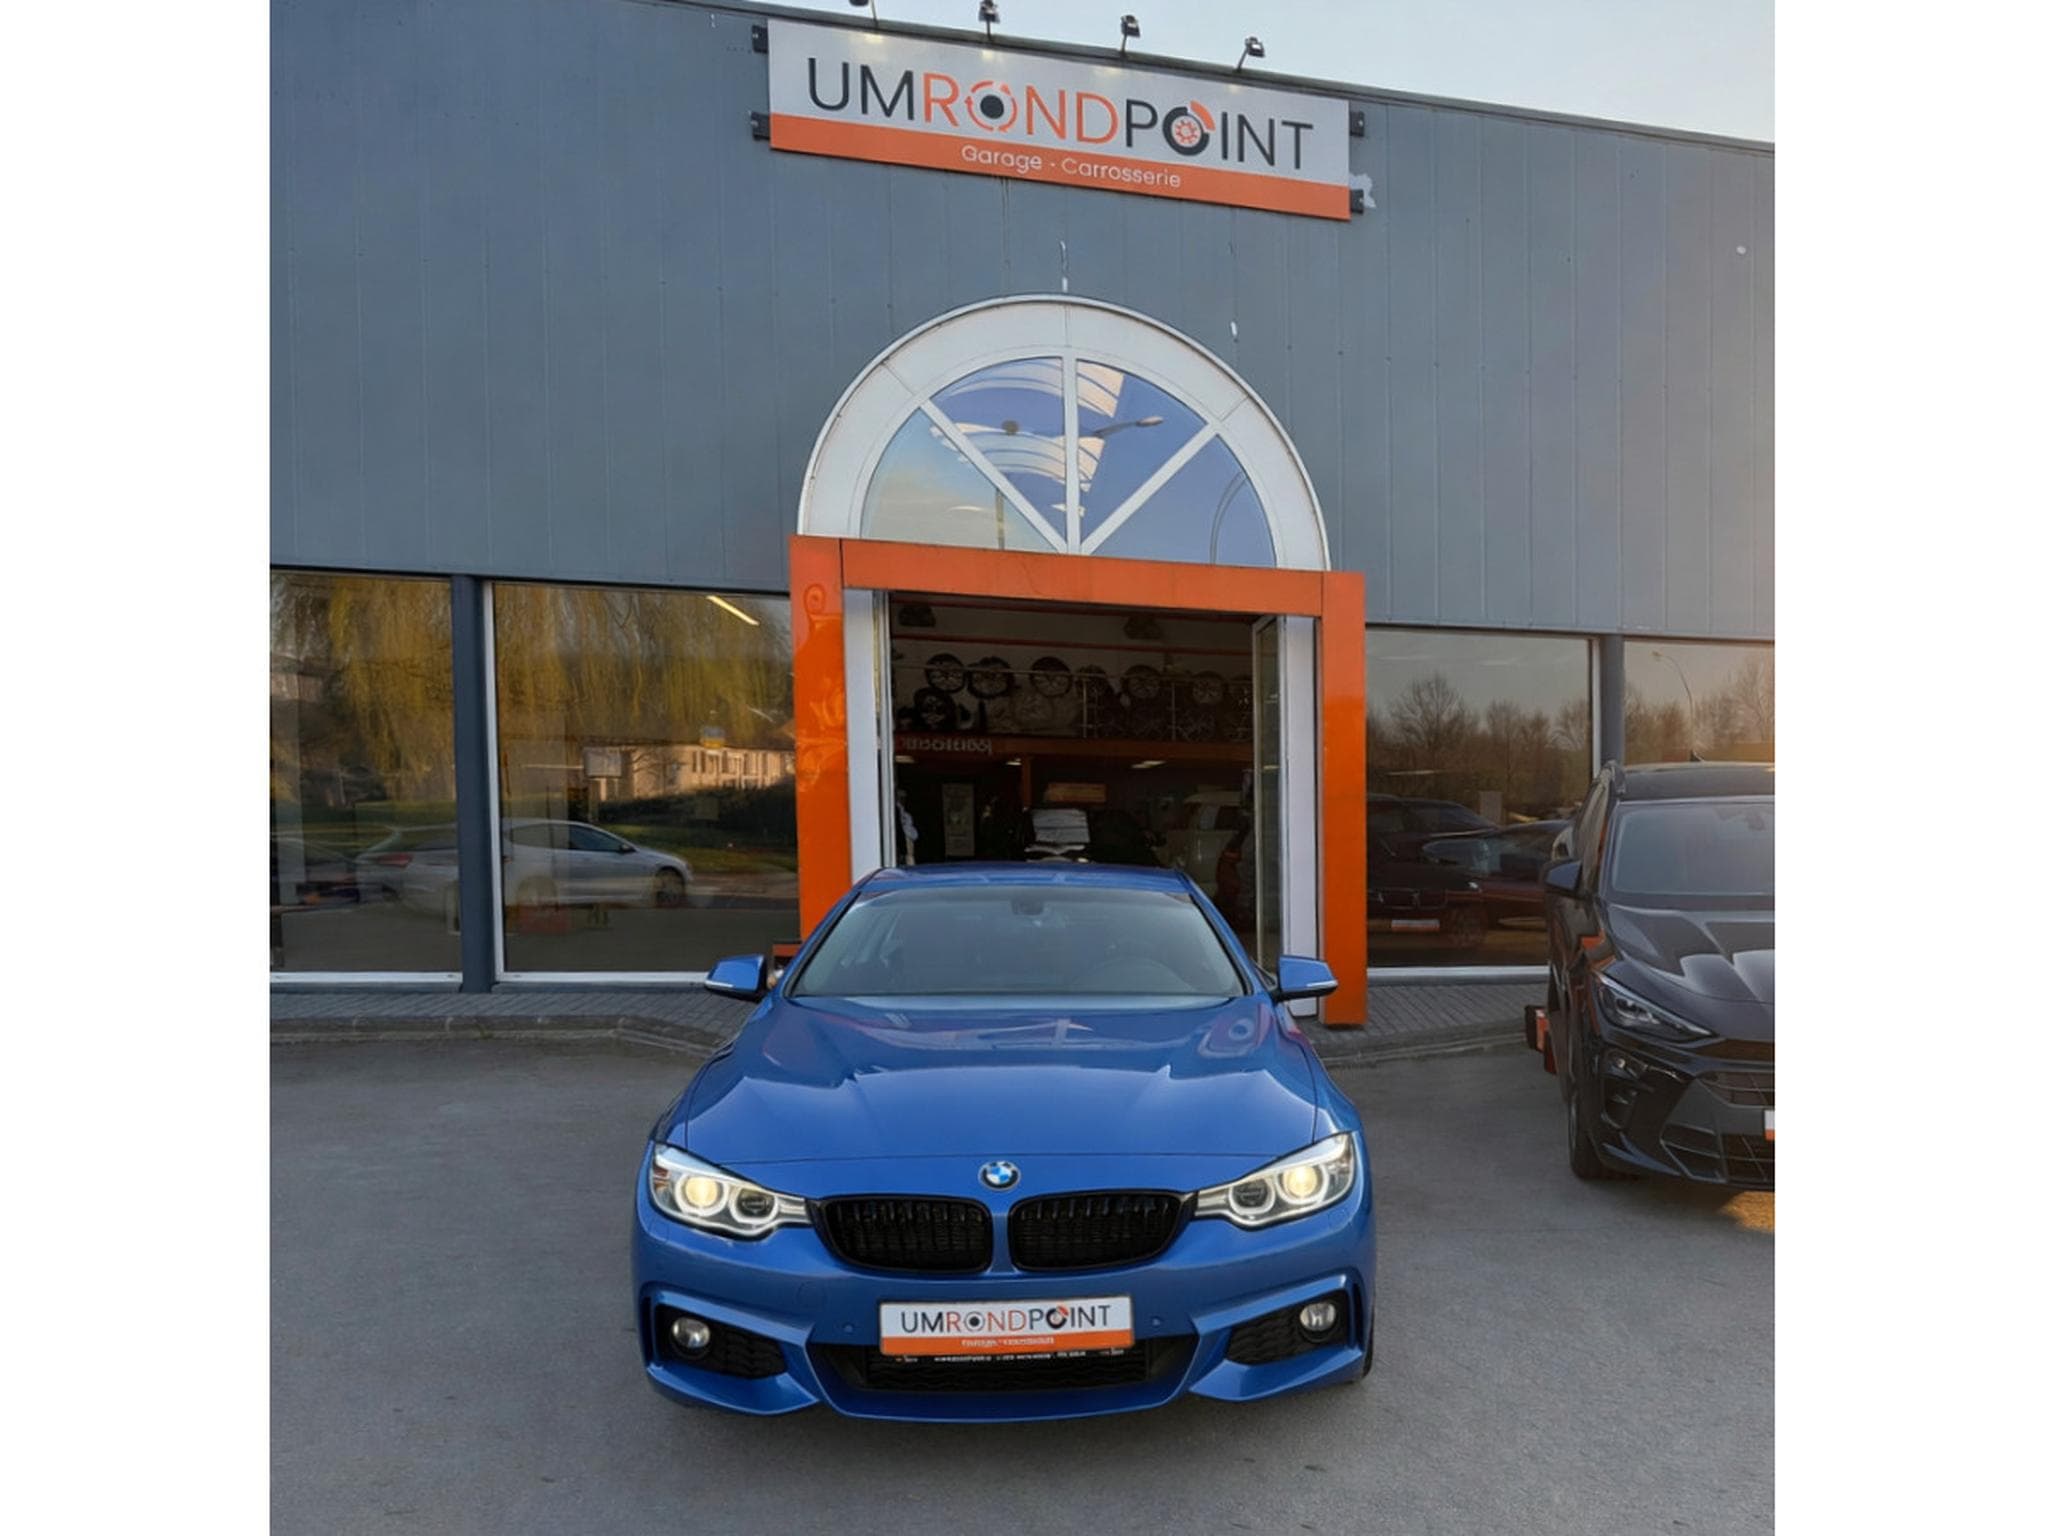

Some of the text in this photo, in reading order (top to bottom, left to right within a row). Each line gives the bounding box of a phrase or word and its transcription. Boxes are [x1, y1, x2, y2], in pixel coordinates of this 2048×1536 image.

[808, 57, 1314, 170] UMRONDPOINT
[961, 144, 1182, 188] Garage Carrosserie
[901, 1304, 1111, 1334] UMRONDPOINT
